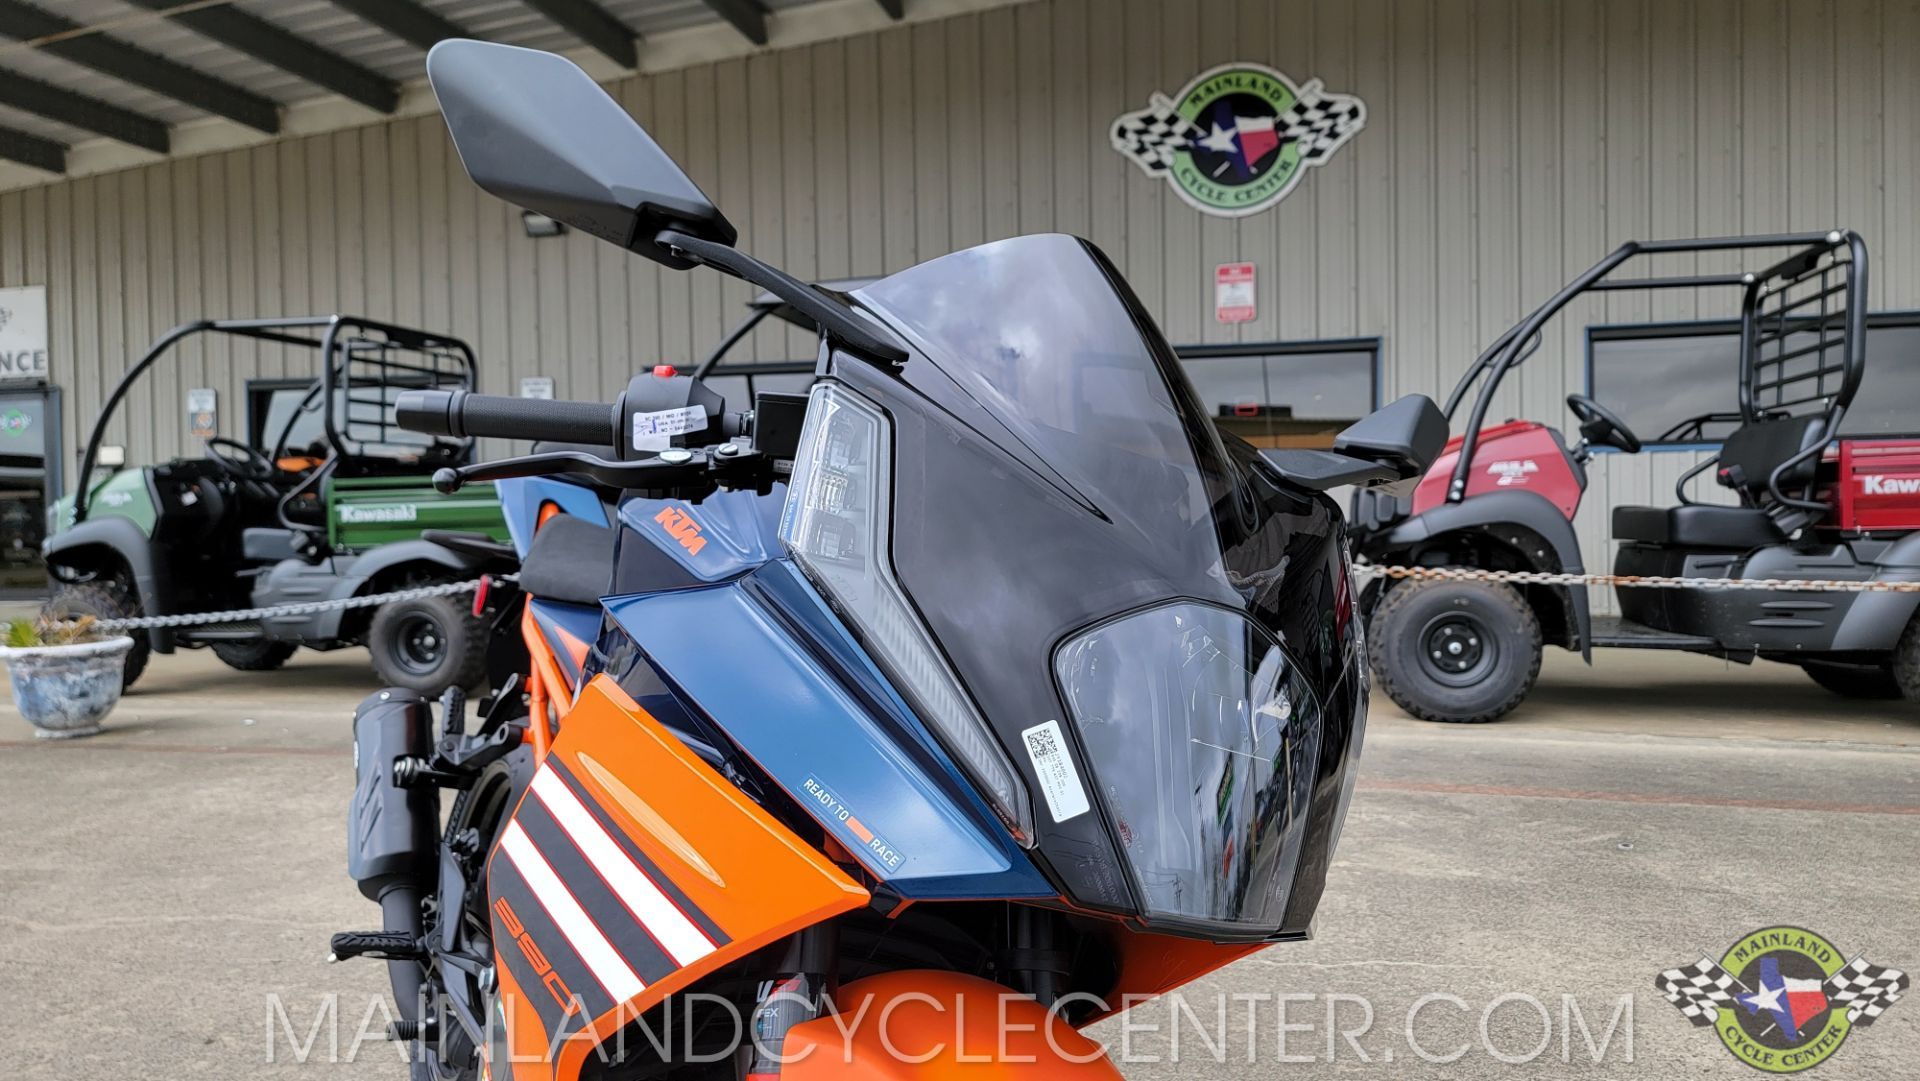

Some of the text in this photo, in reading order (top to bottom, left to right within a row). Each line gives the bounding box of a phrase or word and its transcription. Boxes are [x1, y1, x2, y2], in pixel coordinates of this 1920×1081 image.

[1189, 75, 1283, 107] MAINLAND
[1180, 160, 1293, 202] CYCLE CENTER
[1864, 475, 1920, 495] Kaw
[340, 504, 417, 523] Kawasaki
[654, 505, 708, 556] KTM
[803, 778, 900, 867] READY TO RACE
[493, 896, 582, 1017] 390
